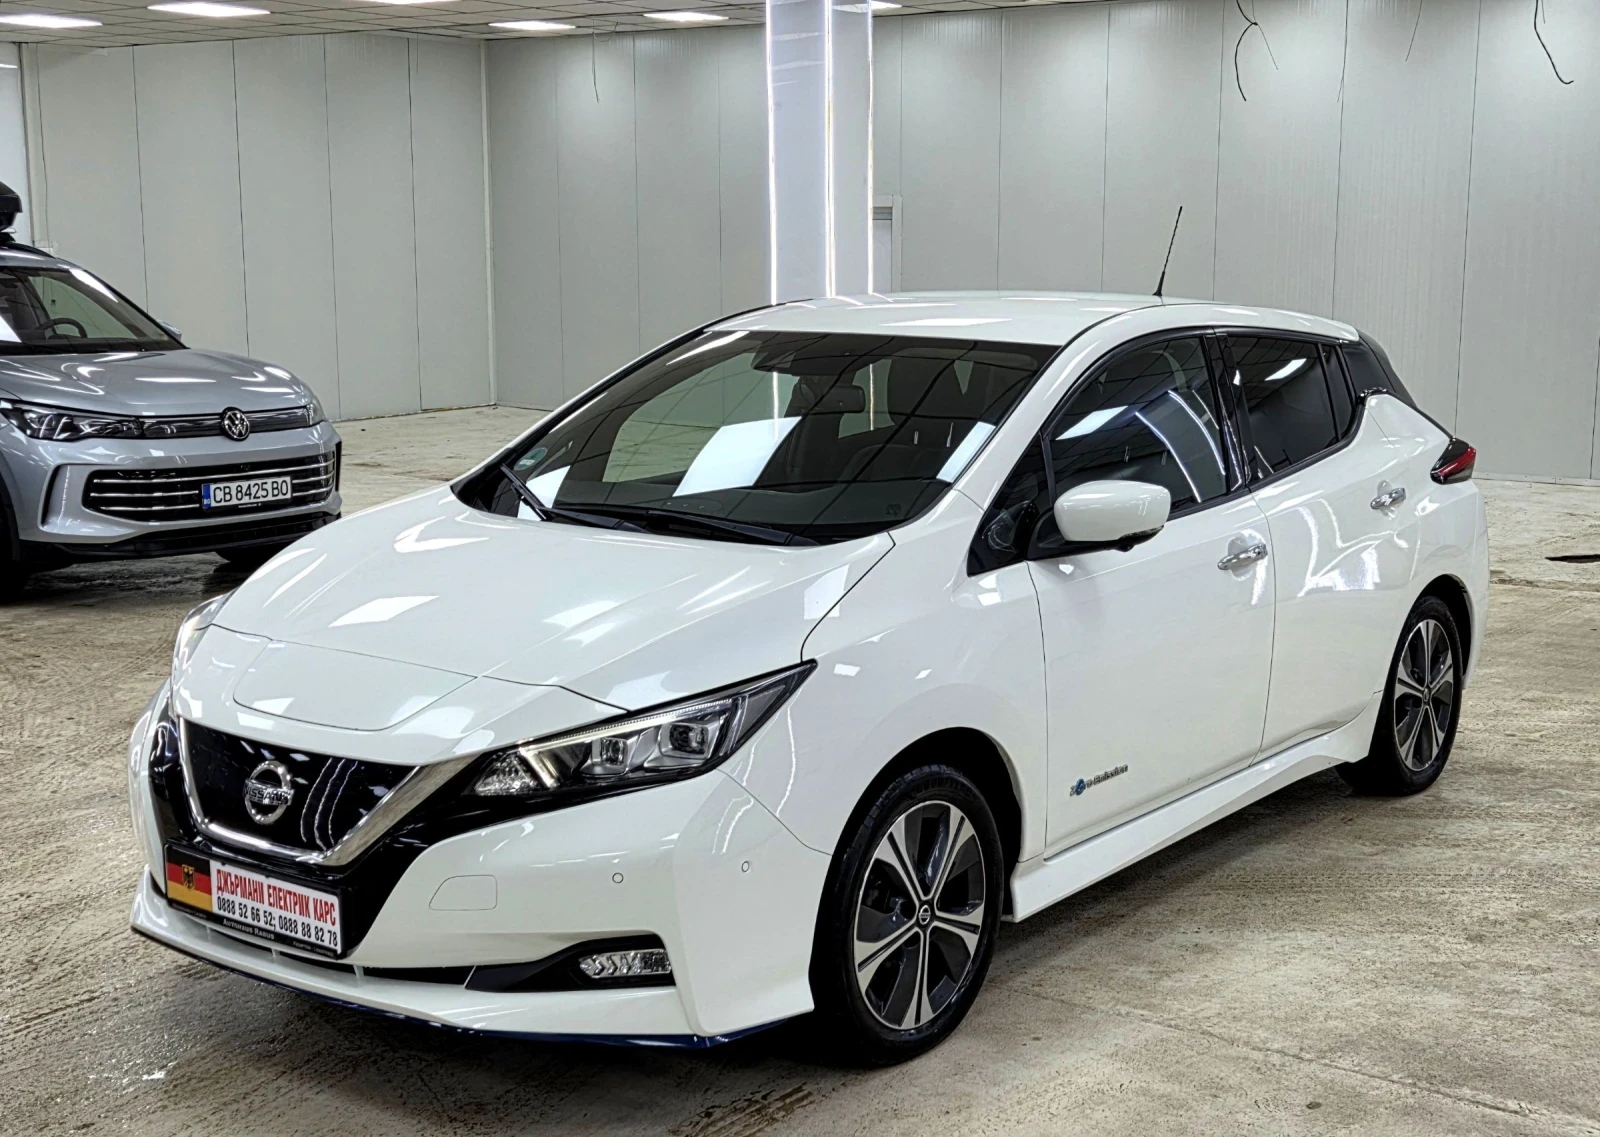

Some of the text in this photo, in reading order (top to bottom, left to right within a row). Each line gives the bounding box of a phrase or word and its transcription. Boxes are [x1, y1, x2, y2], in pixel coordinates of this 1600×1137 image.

[213, 485, 232, 503] CB
[236, 481, 269, 501] 8425
[216, 868, 336, 927] ДЖЪРМАНИ ЕЛЕКТРИК КАРС
[217, 896, 236, 915] 0888
[238, 902, 248, 919] 52
[251, 906, 261, 923] 66
[263, 910, 276, 931] 52;
[278, 915, 298, 935] 0888
[301, 921, 312, 939] 88
[314, 926, 325, 943] 82
[327, 930, 338, 947] 78
